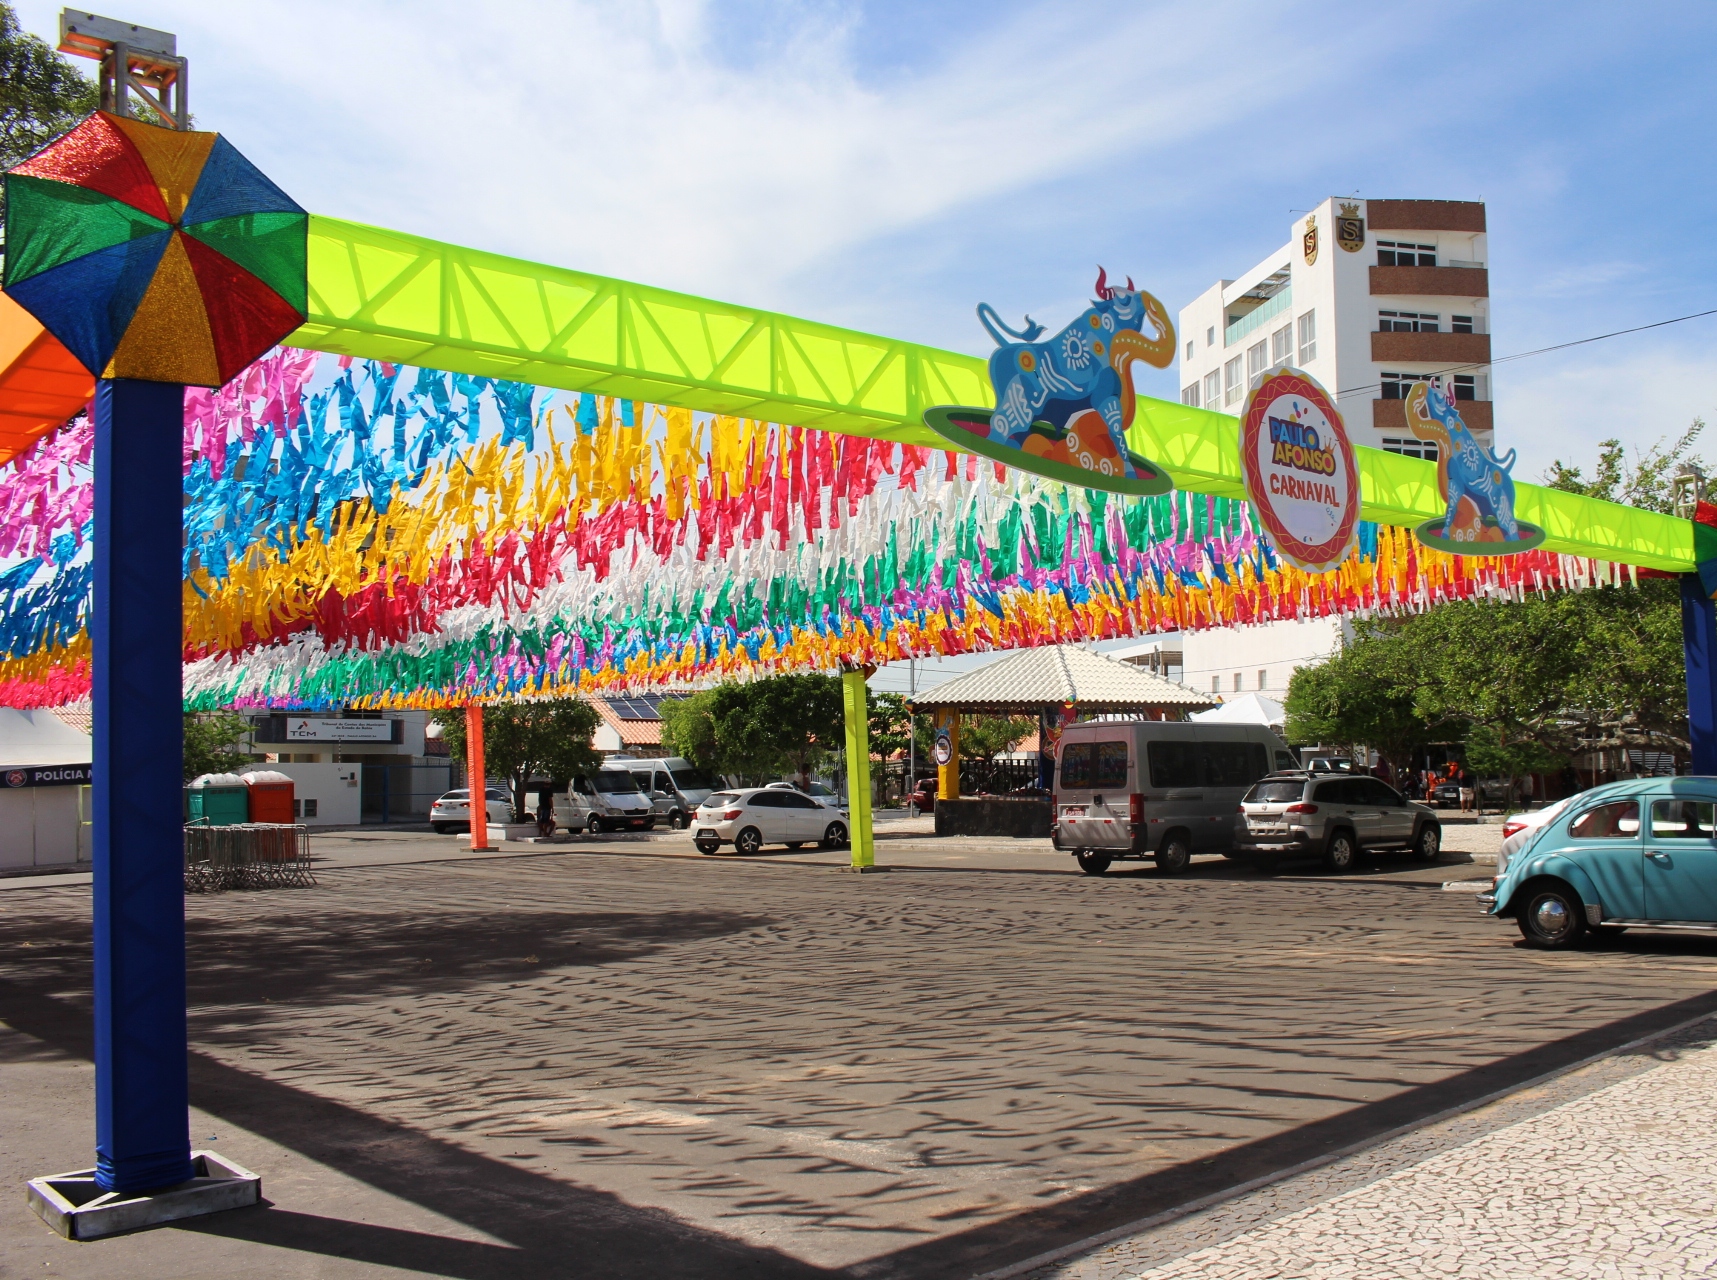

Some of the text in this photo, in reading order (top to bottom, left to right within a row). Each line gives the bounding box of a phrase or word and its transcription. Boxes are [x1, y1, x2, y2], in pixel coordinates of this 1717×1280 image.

[1342, 220, 1358, 240] S
[1270, 418, 1319, 450] PAULO
[1273, 443, 1336, 475] AFONSO
[1270, 473, 1340, 508] CARNAVAL
[35, 768, 84, 781] POLÍCIA
